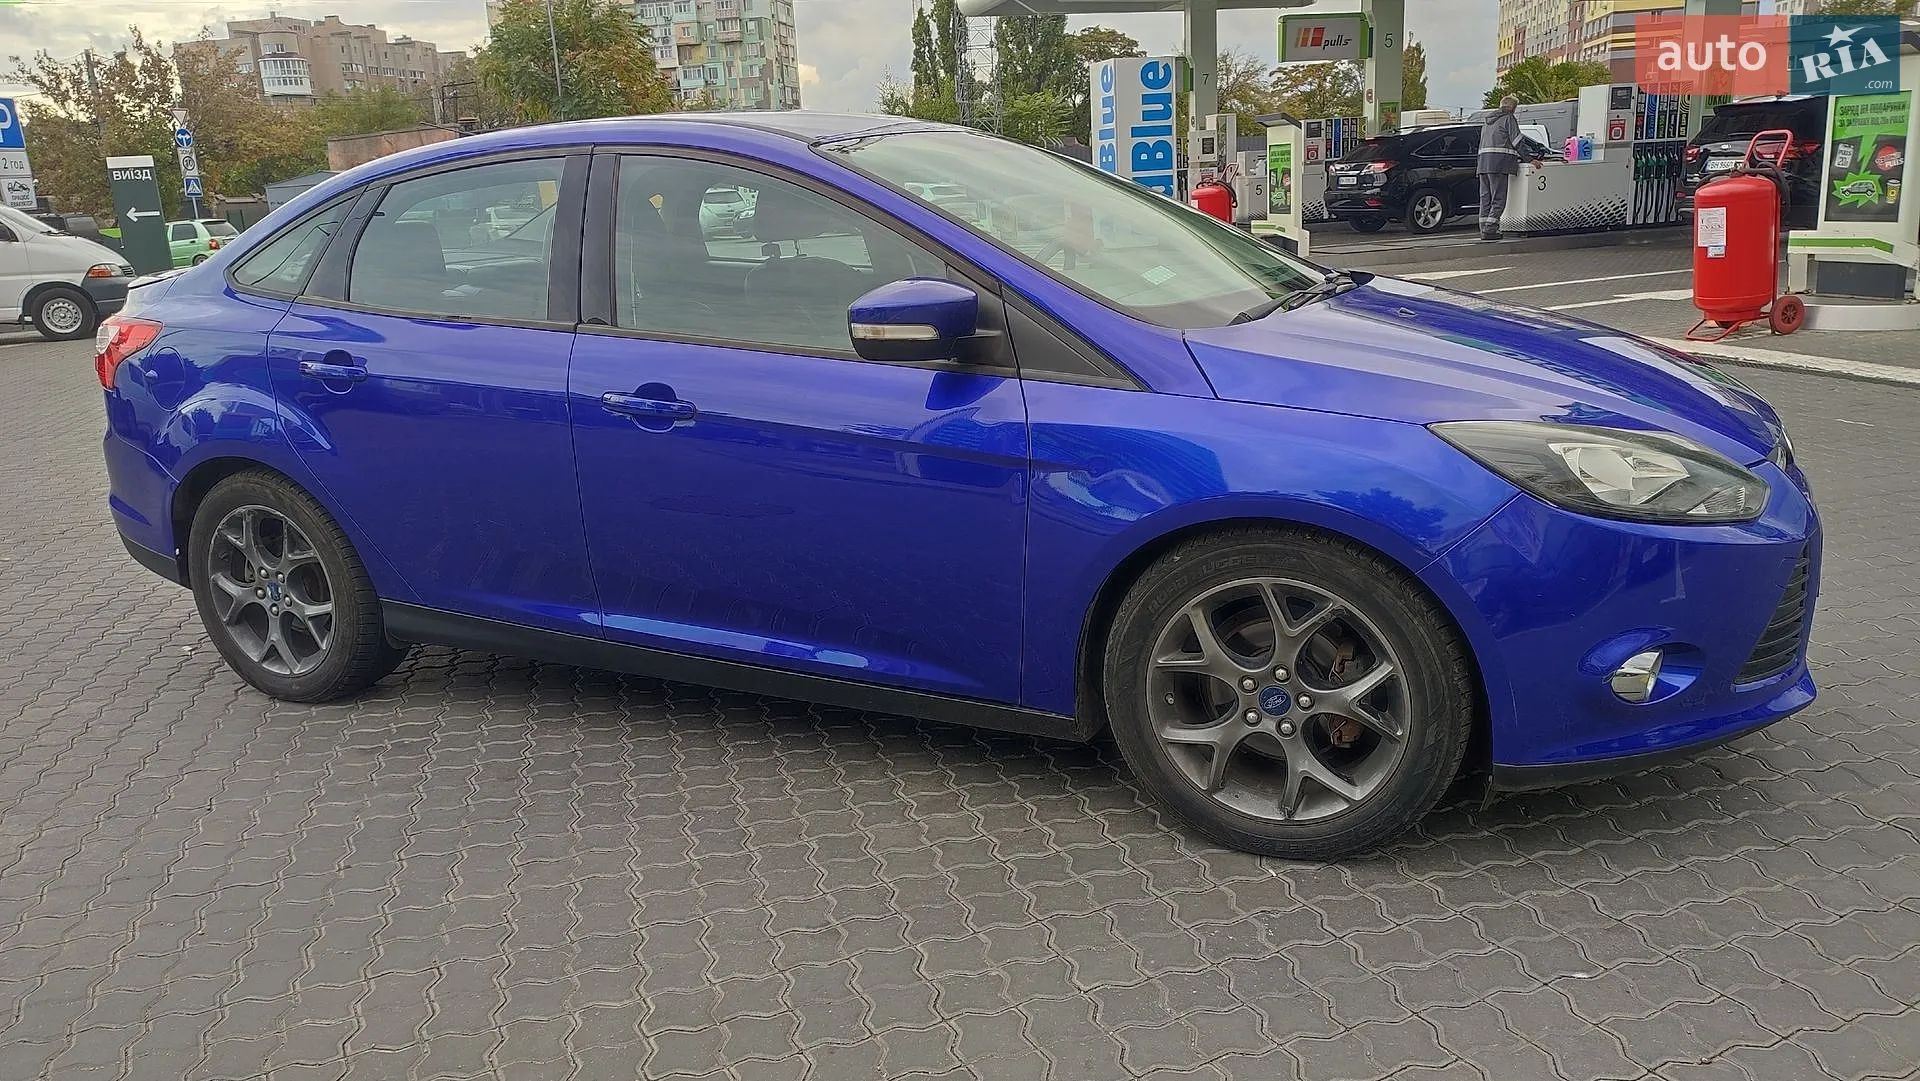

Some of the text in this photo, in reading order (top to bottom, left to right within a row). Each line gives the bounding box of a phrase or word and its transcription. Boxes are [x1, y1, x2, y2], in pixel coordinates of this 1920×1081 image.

[1323, 35, 1352, 50] pulls
[1384, 33, 1393, 48] 5
[1200, 73, 1209, 85] 7
[1098, 64, 1116, 174] Blue
[2, 157, 25, 170] 2 год
[112, 168, 152, 181] ВИЇЗД
[1255, 184, 1263, 196] 5
[1537, 175, 1547, 191] 3
